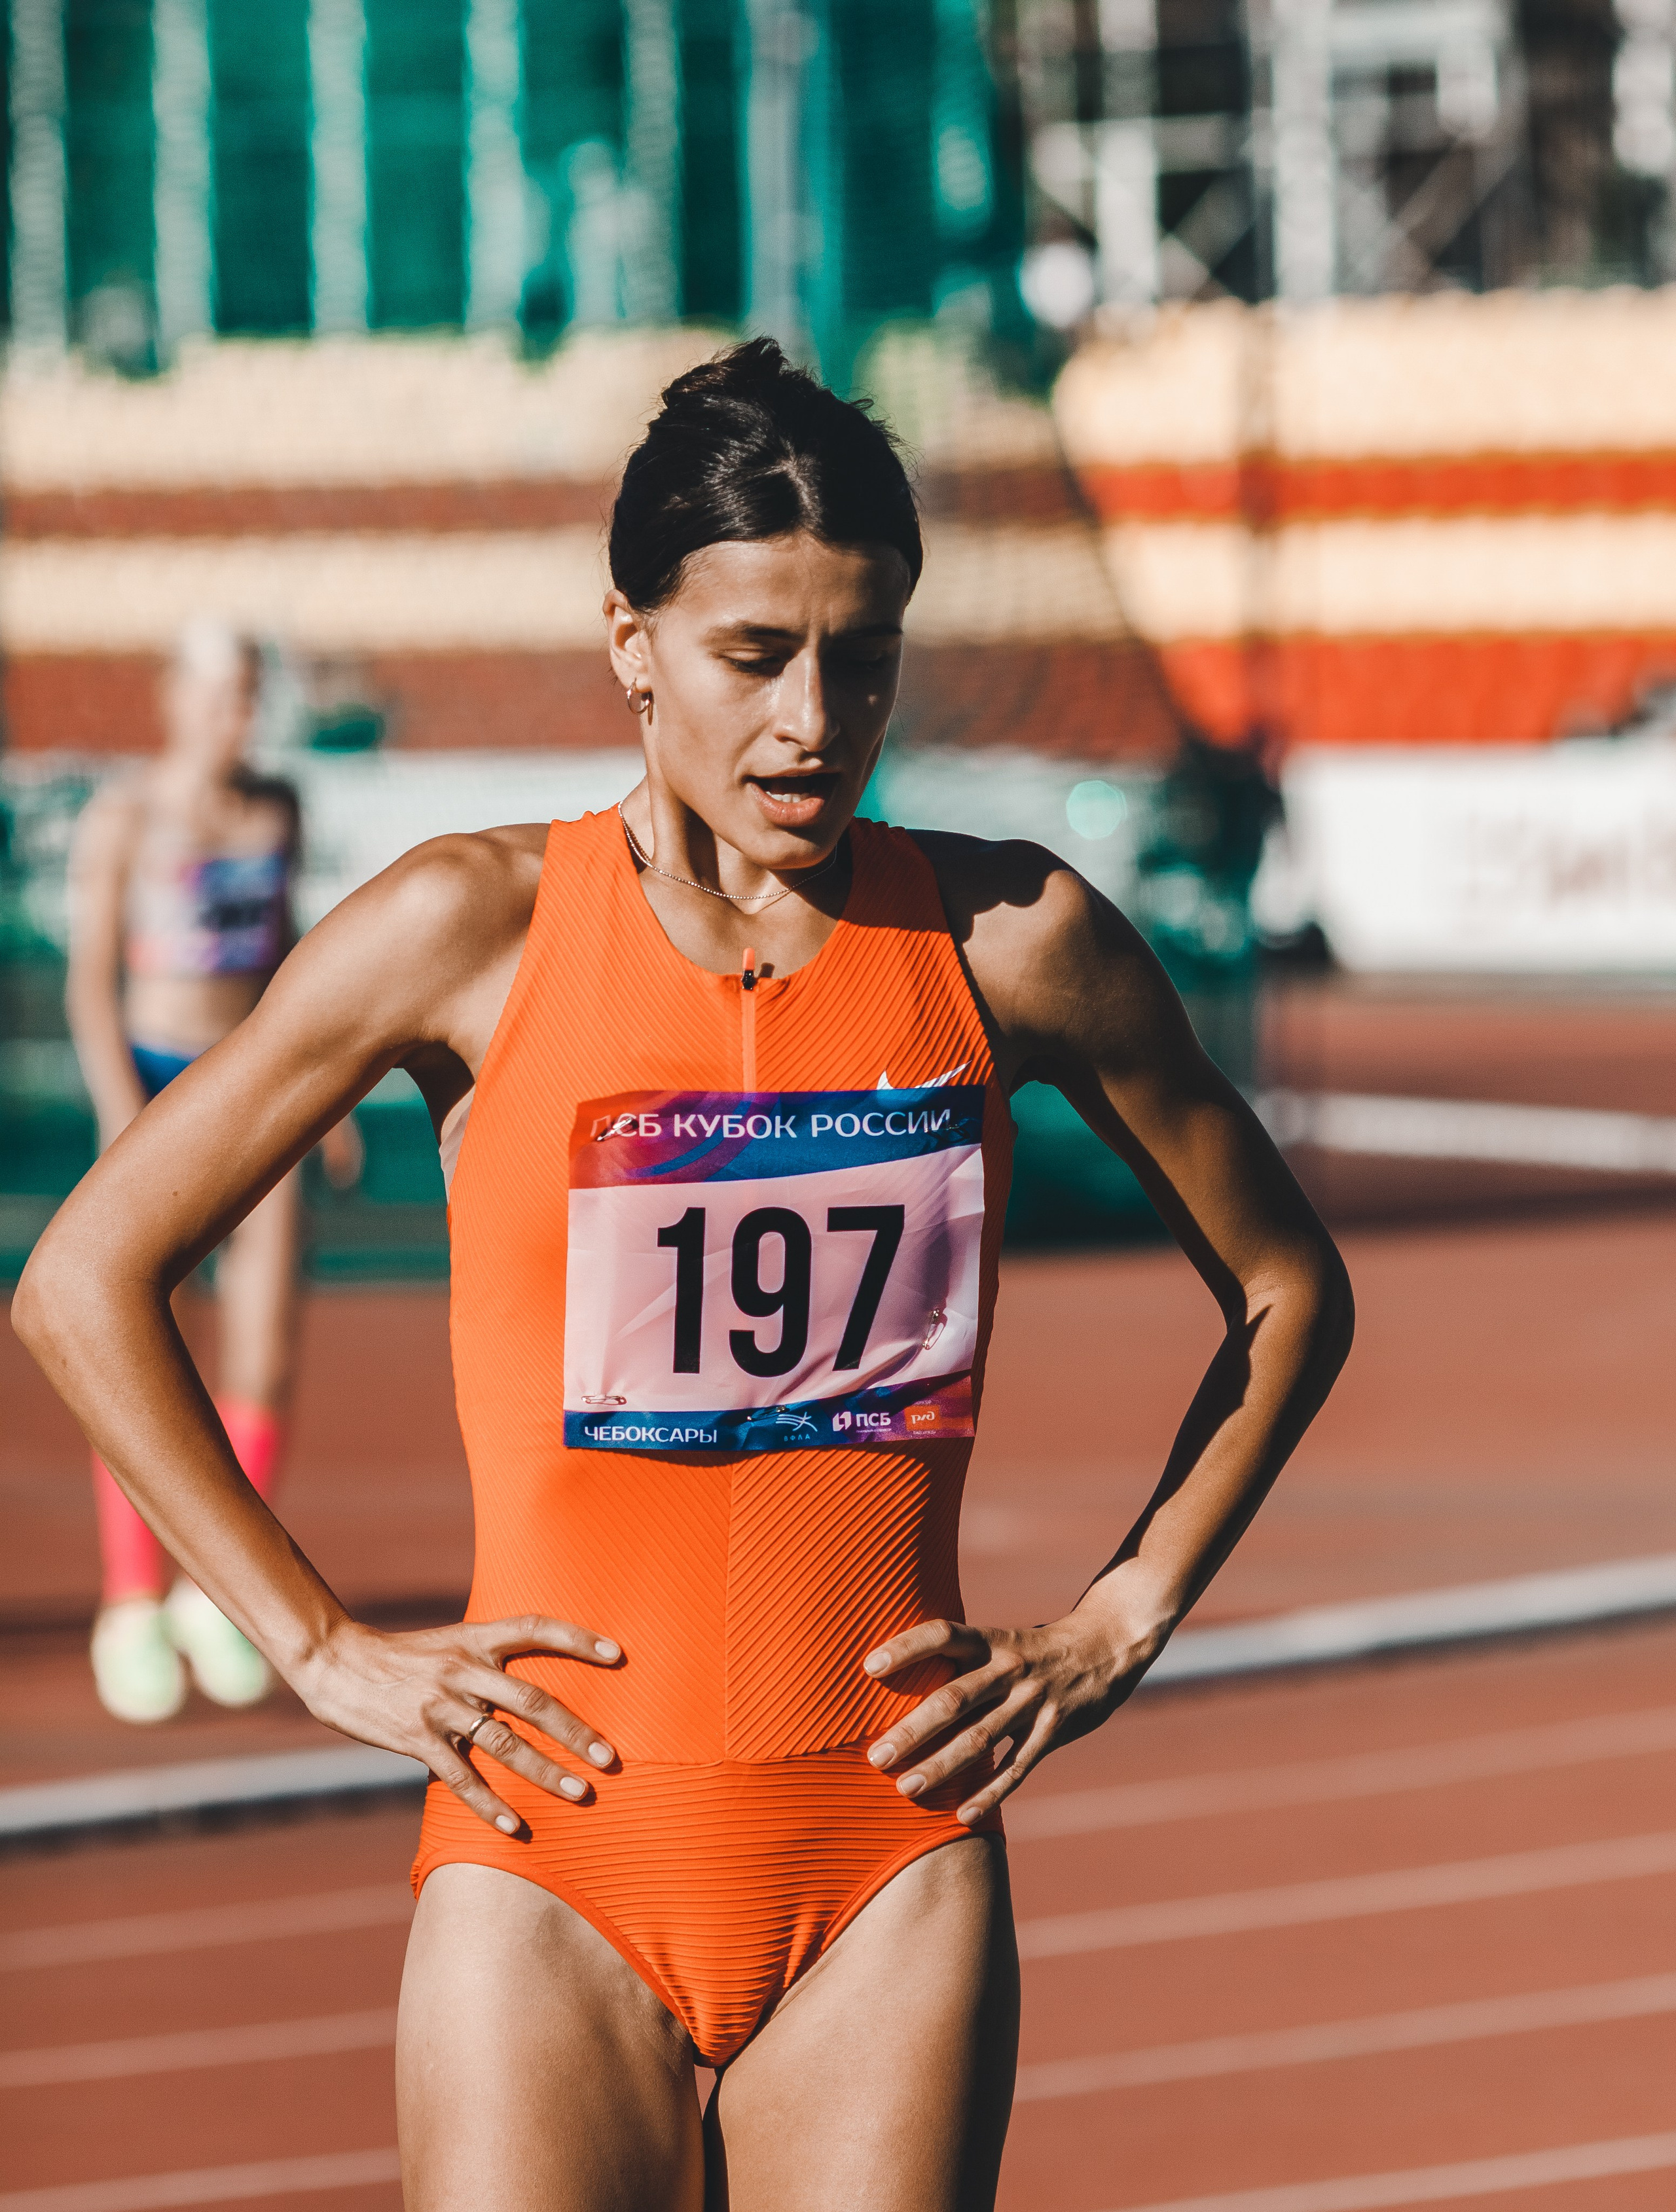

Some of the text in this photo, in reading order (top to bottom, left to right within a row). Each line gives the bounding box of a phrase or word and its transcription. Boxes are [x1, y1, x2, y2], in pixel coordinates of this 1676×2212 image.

[673, 1114, 797, 1139] КУБОК
[811, 1108, 951, 1138] РОССИИ
[657, 1205, 905, 1378] 197
[856, 1413, 891, 1427] ПСБ
[585, 1426, 718, 1443] ЧЕБОКСАРЫ
